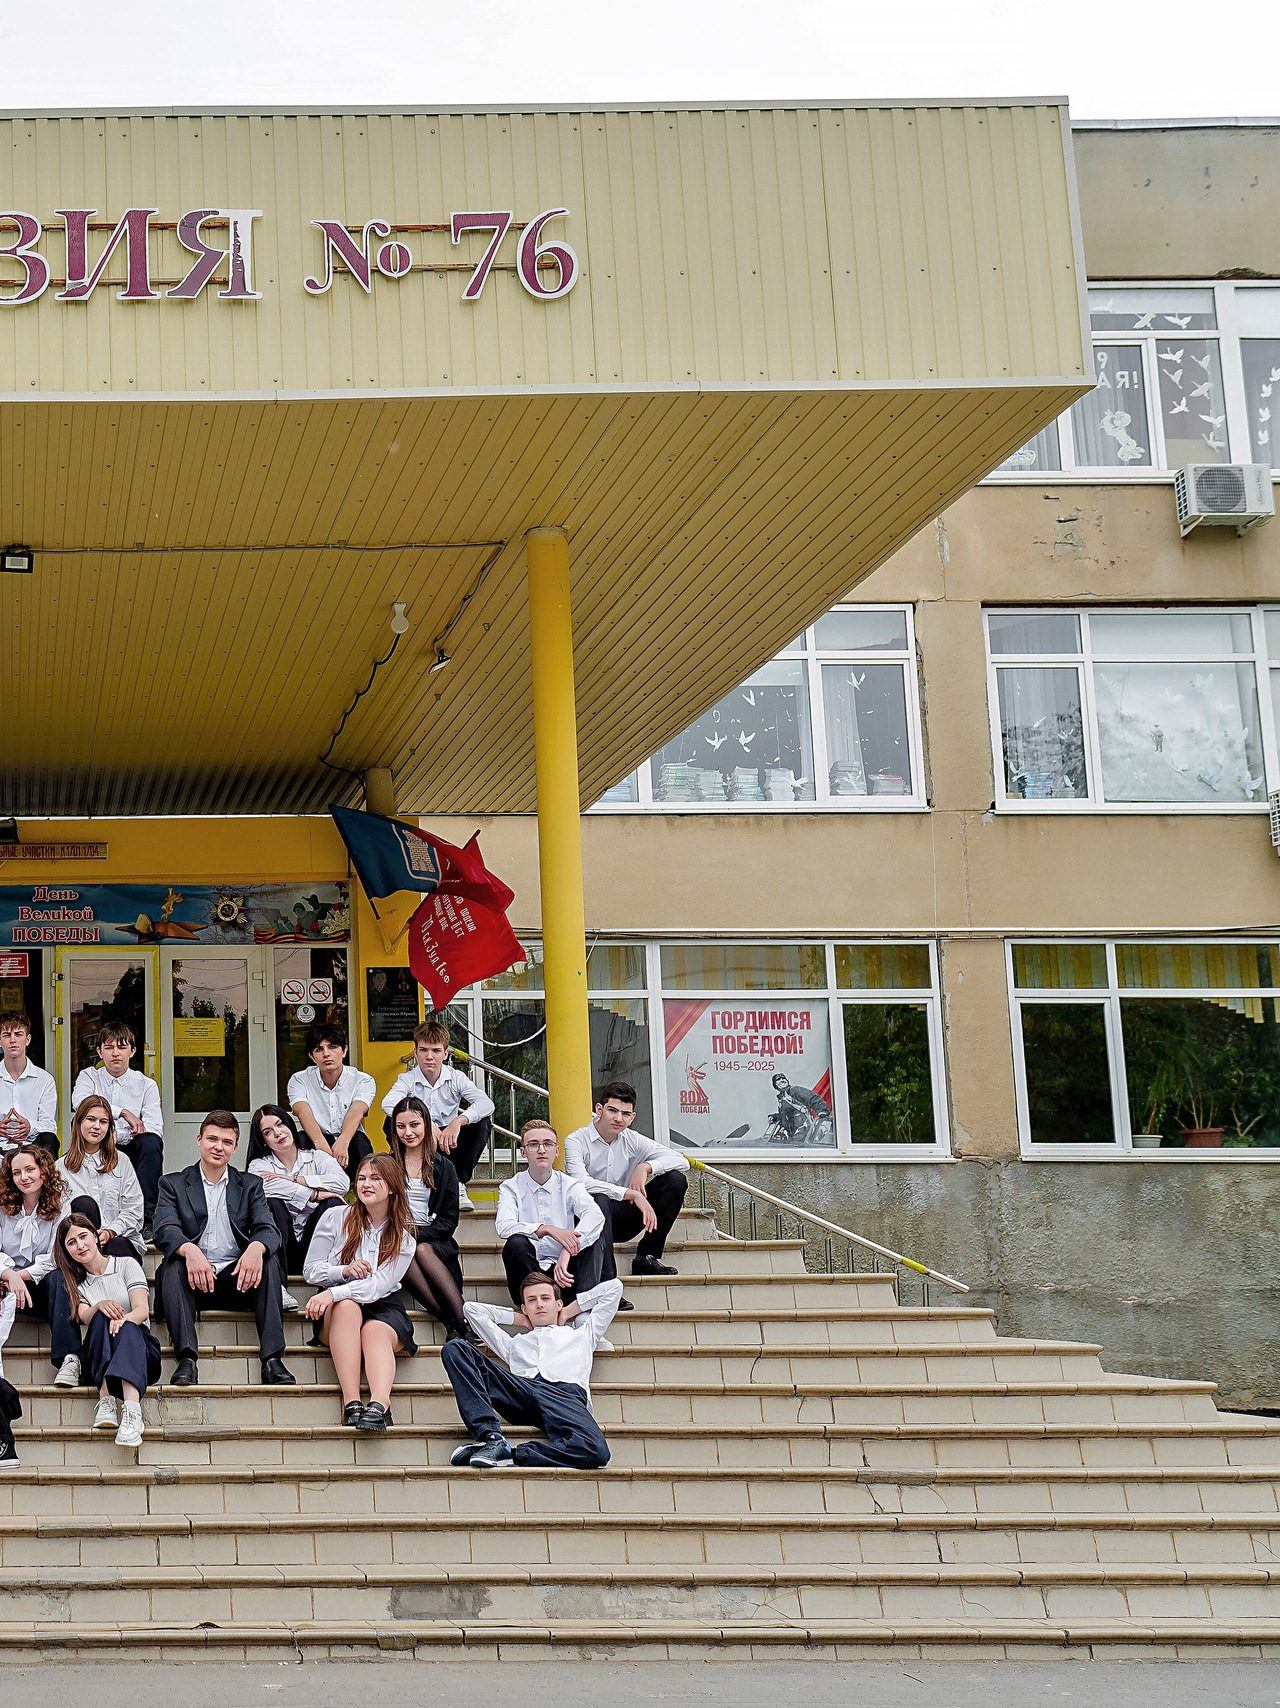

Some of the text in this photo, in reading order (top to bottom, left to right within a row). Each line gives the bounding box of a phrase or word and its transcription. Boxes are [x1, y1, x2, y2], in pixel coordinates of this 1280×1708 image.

[303, 218, 413, 295] №
[449, 207, 579, 300] 76
[22, 845, 55, 858] УЧАСТКИ
[32, 887, 79, 902] День
[19, 906, 94, 921] Великой
[422, 914, 434, 933] 79
[12, 927, 100, 943] ПОБЕДЫ
[711, 1011, 811, 1033] ГОРДИМСЯ
[712, 1033, 804, 1057] ПОБЕДОЙ!
[680, 1090, 694, 1104] 80
[680, 1106, 710, 1114] ПОБЕДА!
